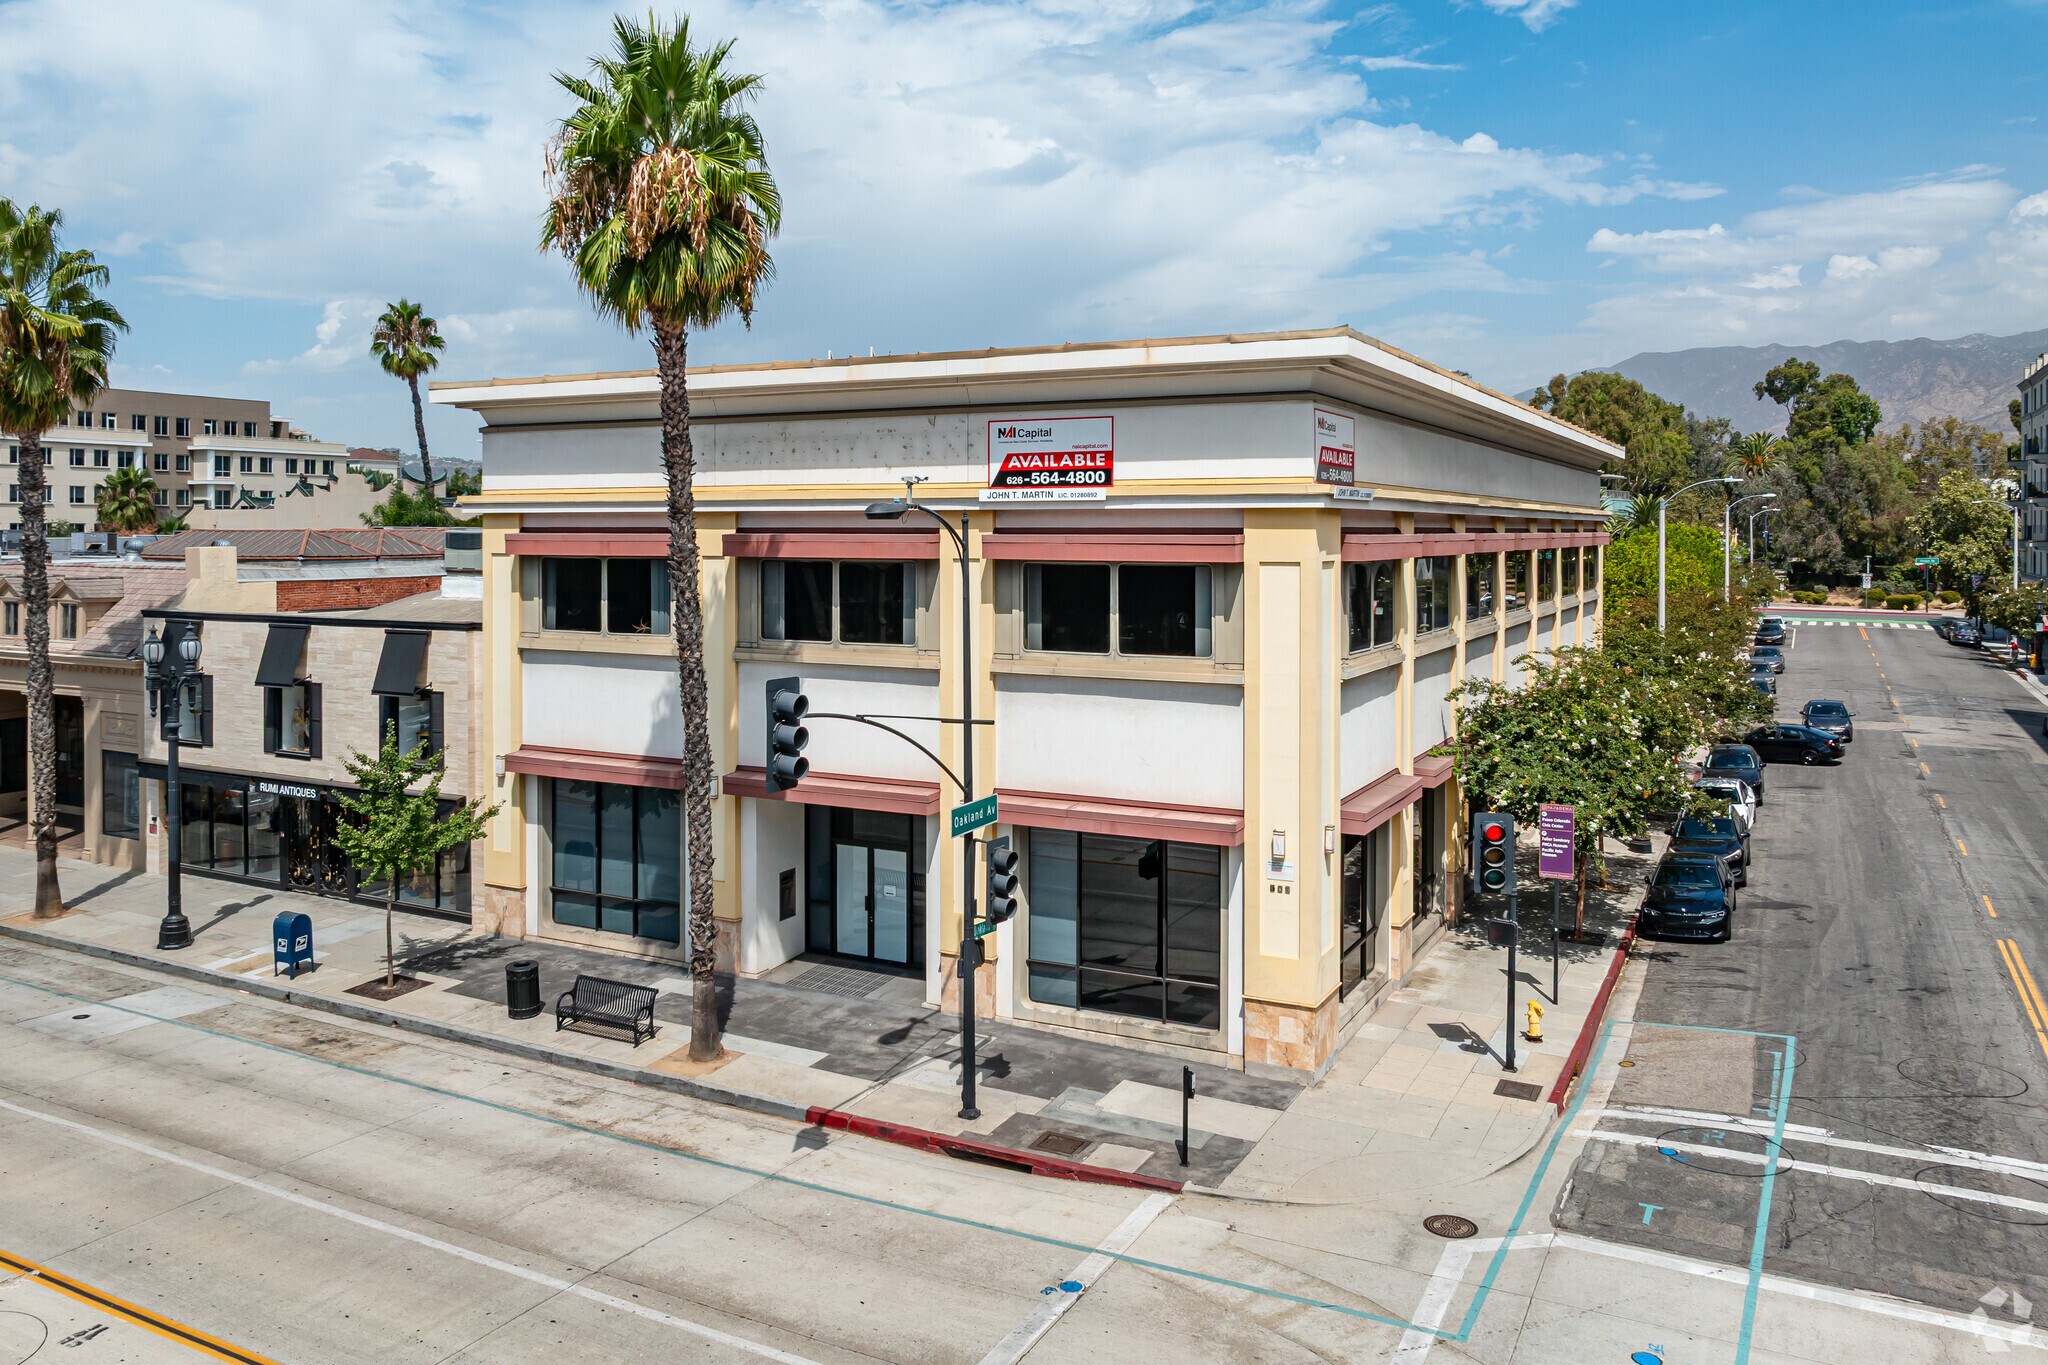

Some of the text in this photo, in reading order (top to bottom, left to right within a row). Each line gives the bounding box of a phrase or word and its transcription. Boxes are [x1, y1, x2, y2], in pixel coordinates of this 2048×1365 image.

[998, 425, 1052, 440] NAI Capital
[1007, 453, 1106, 468] AVAILABLE
[1321, 449, 1353, 466] AVAILABLE
[1006, 471, 1106, 485] 626-564-4800
[986, 491, 1010, 499] JOHN
[1012, 491, 1019, 499] T.
[1021, 490, 1054, 499] MARTIN
[260, 782, 316, 799] RUMI ANTIQUES
[954, 805, 996, 828] Oakland Av
